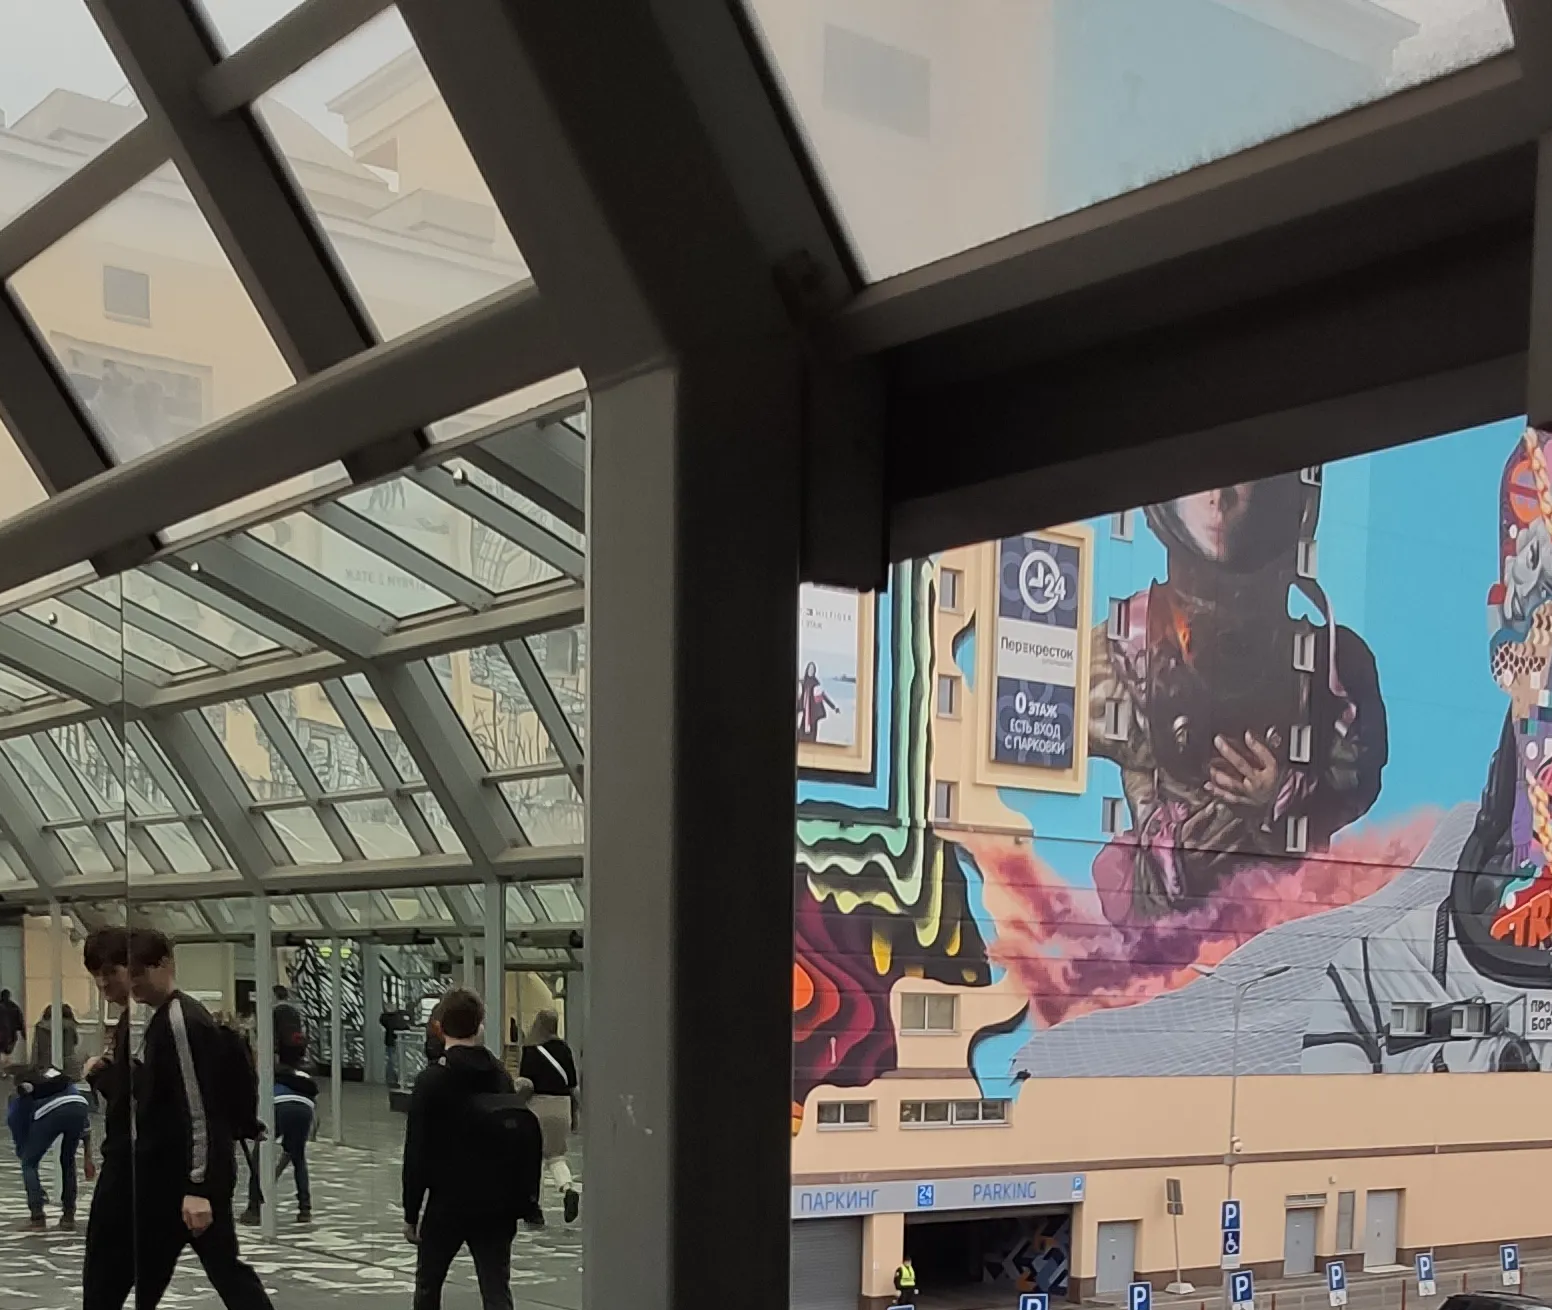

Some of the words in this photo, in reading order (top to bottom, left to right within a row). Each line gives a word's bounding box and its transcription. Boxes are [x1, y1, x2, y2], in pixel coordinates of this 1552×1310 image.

[1043, 572, 1066, 601] 24
[1001, 635, 1074, 661] Перекресток
[1028, 701, 1058, 719] ЭТАЖ
[1009, 717, 1033, 735] ЕСТЬ
[1033, 721, 1061, 740] ВХОД
[1004, 734, 1012, 749] С
[1013, 735, 1065, 756] ПАРКОВКИ
[800, 1189, 879, 1211] ПАРКИНГ
[919, 1186, 932, 1199] 24
[973, 1181, 1037, 1201] PARKING
[1224, 1203, 1237, 1227] P
[1420, 1257, 1430, 1279] P
[1504, 1248, 1514, 1270] P
[1331, 1265, 1342, 1288] P
[1235, 1276, 1249, 1300] P
